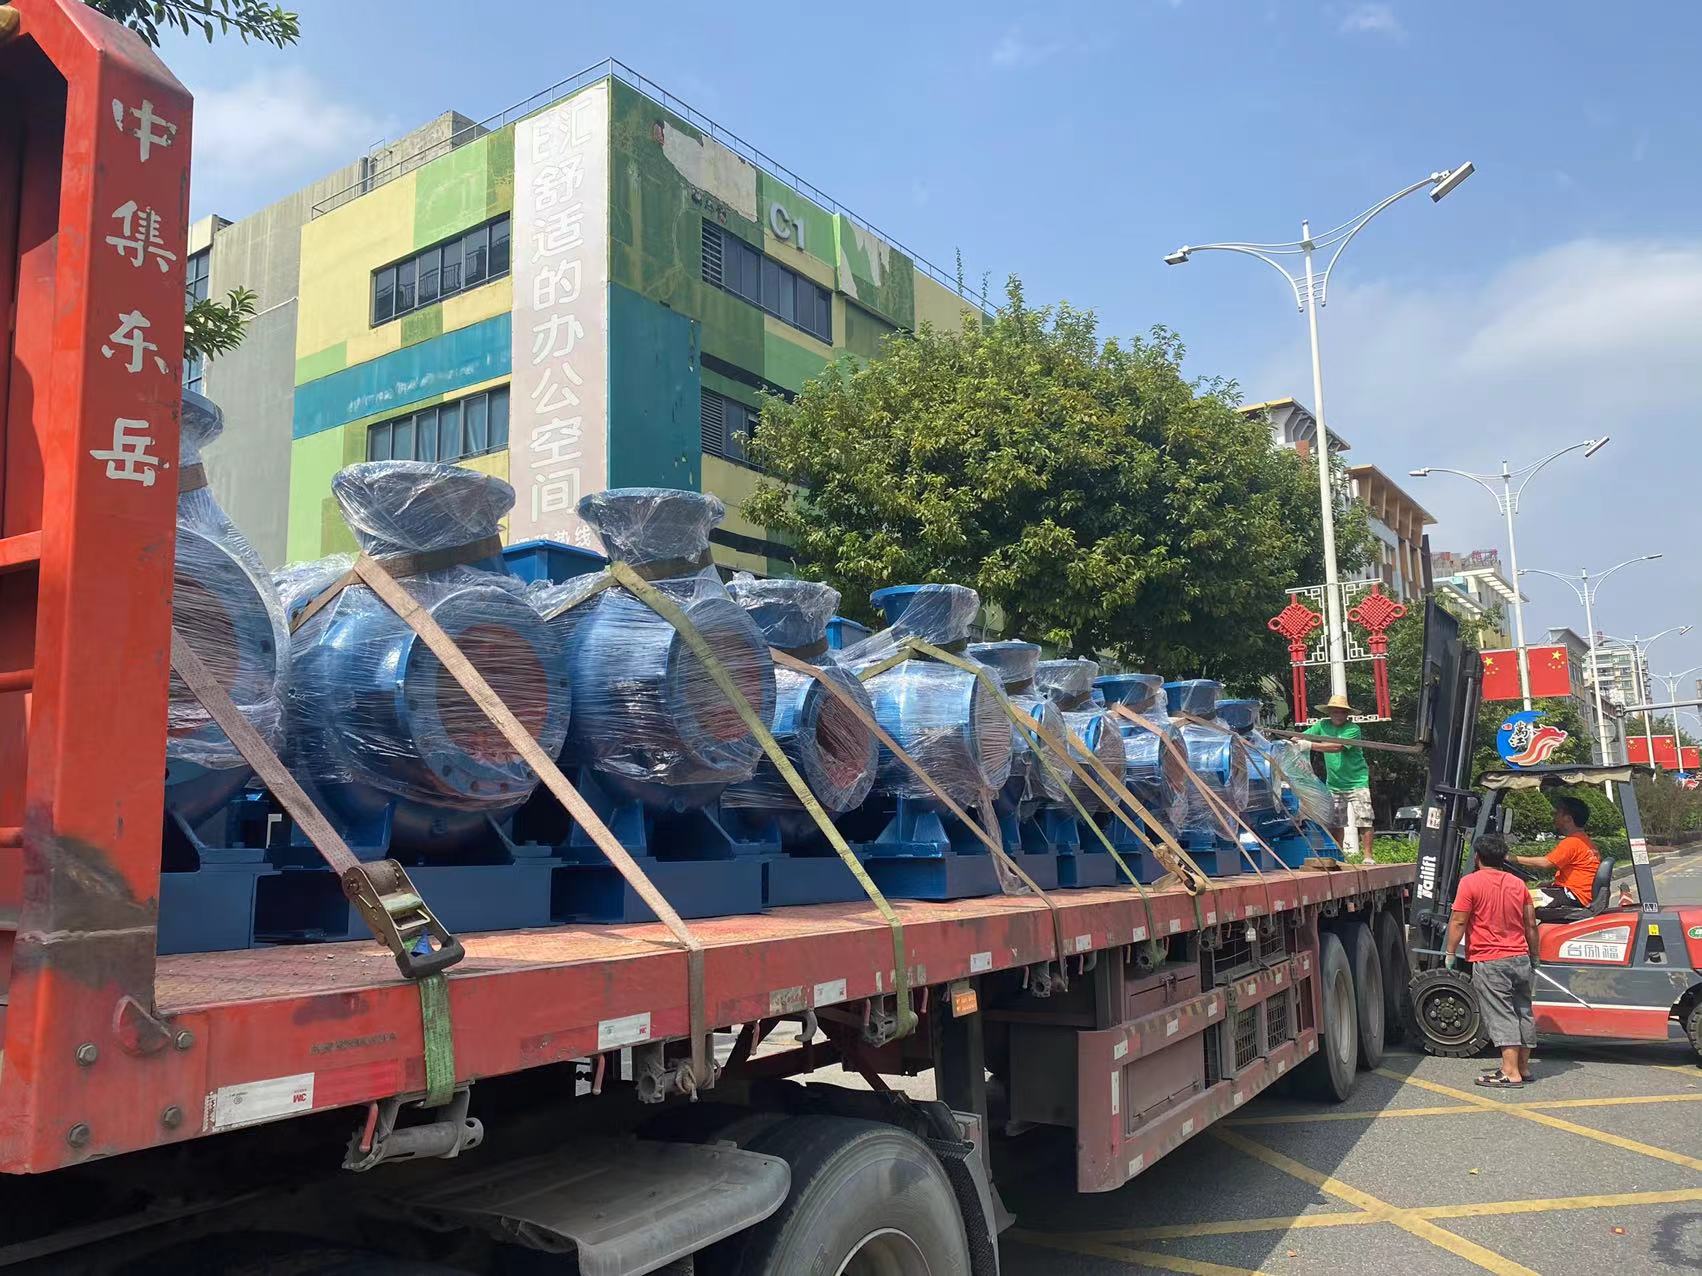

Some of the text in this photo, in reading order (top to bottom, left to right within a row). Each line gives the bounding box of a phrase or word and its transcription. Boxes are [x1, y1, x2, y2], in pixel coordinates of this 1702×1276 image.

[769, 202, 806, 250] C1
[1417, 856, 1437, 899] Tailift
[1567, 943, 1619, 959] 台励福
